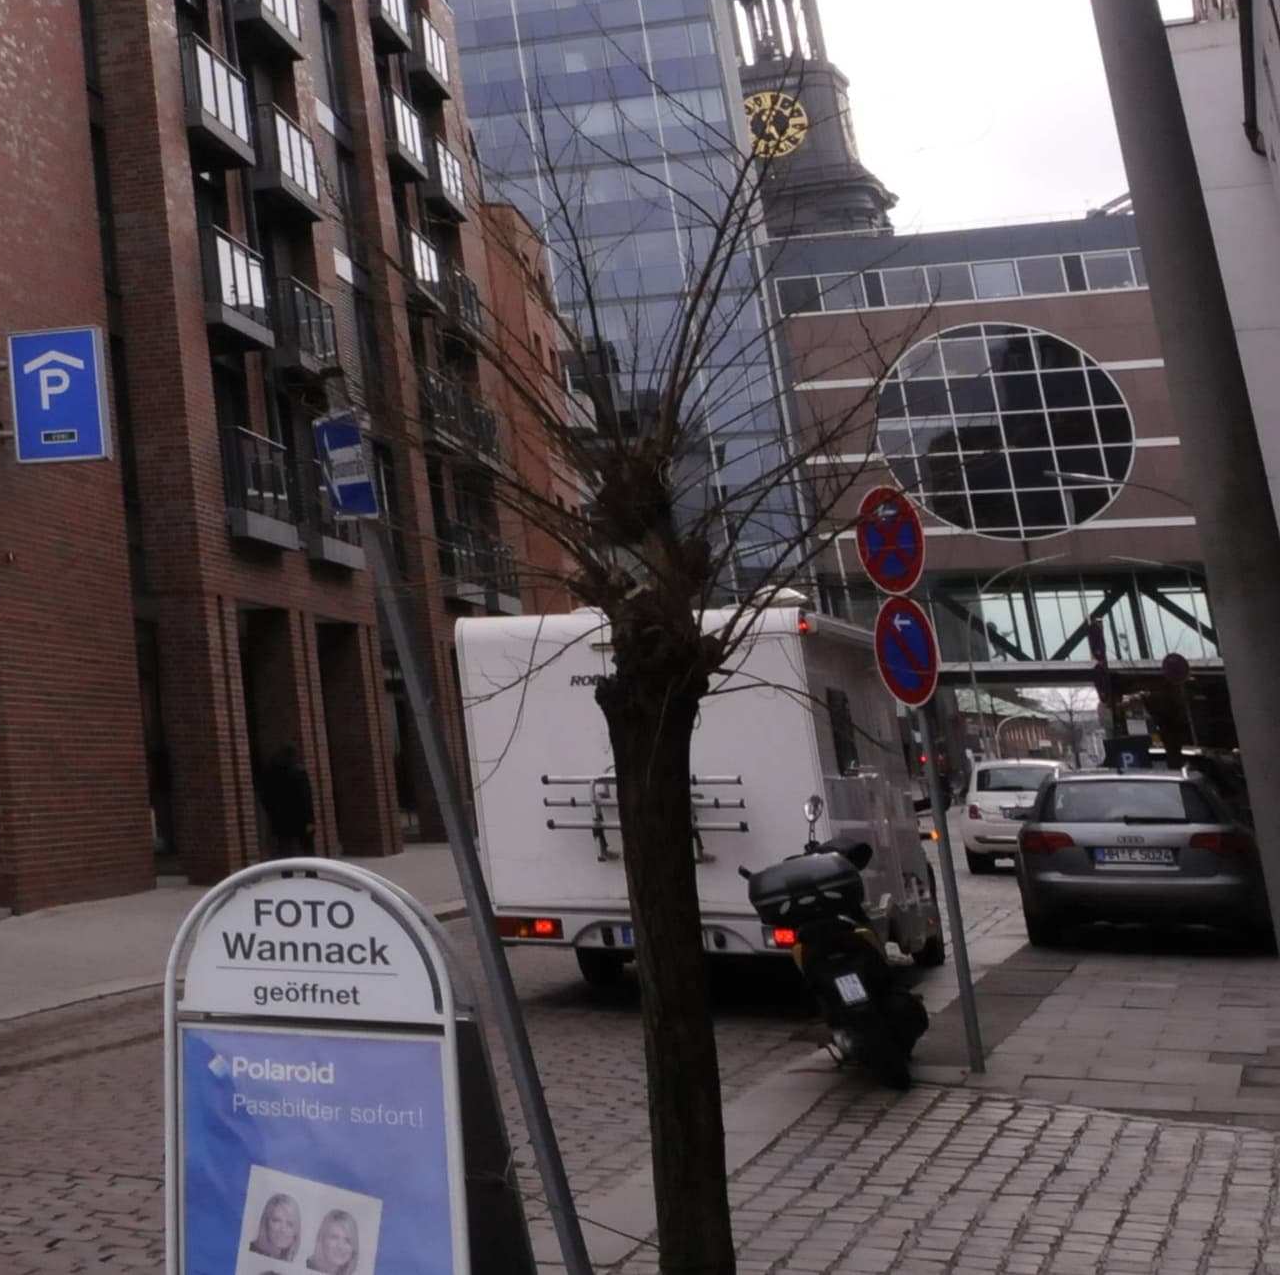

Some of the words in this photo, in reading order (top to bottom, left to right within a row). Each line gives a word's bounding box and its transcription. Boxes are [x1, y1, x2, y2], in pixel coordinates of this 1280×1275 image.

[40, 368, 70, 410] P
[254, 899, 355, 929] FOTO
[222, 931, 391, 966] Wannack
[253, 981, 361, 1006] geöffnet
[232, 1056, 335, 1084] Polaroid
[232, 1093, 342, 1121] Passbilder
[350, 1103, 424, 1128] sofort!
